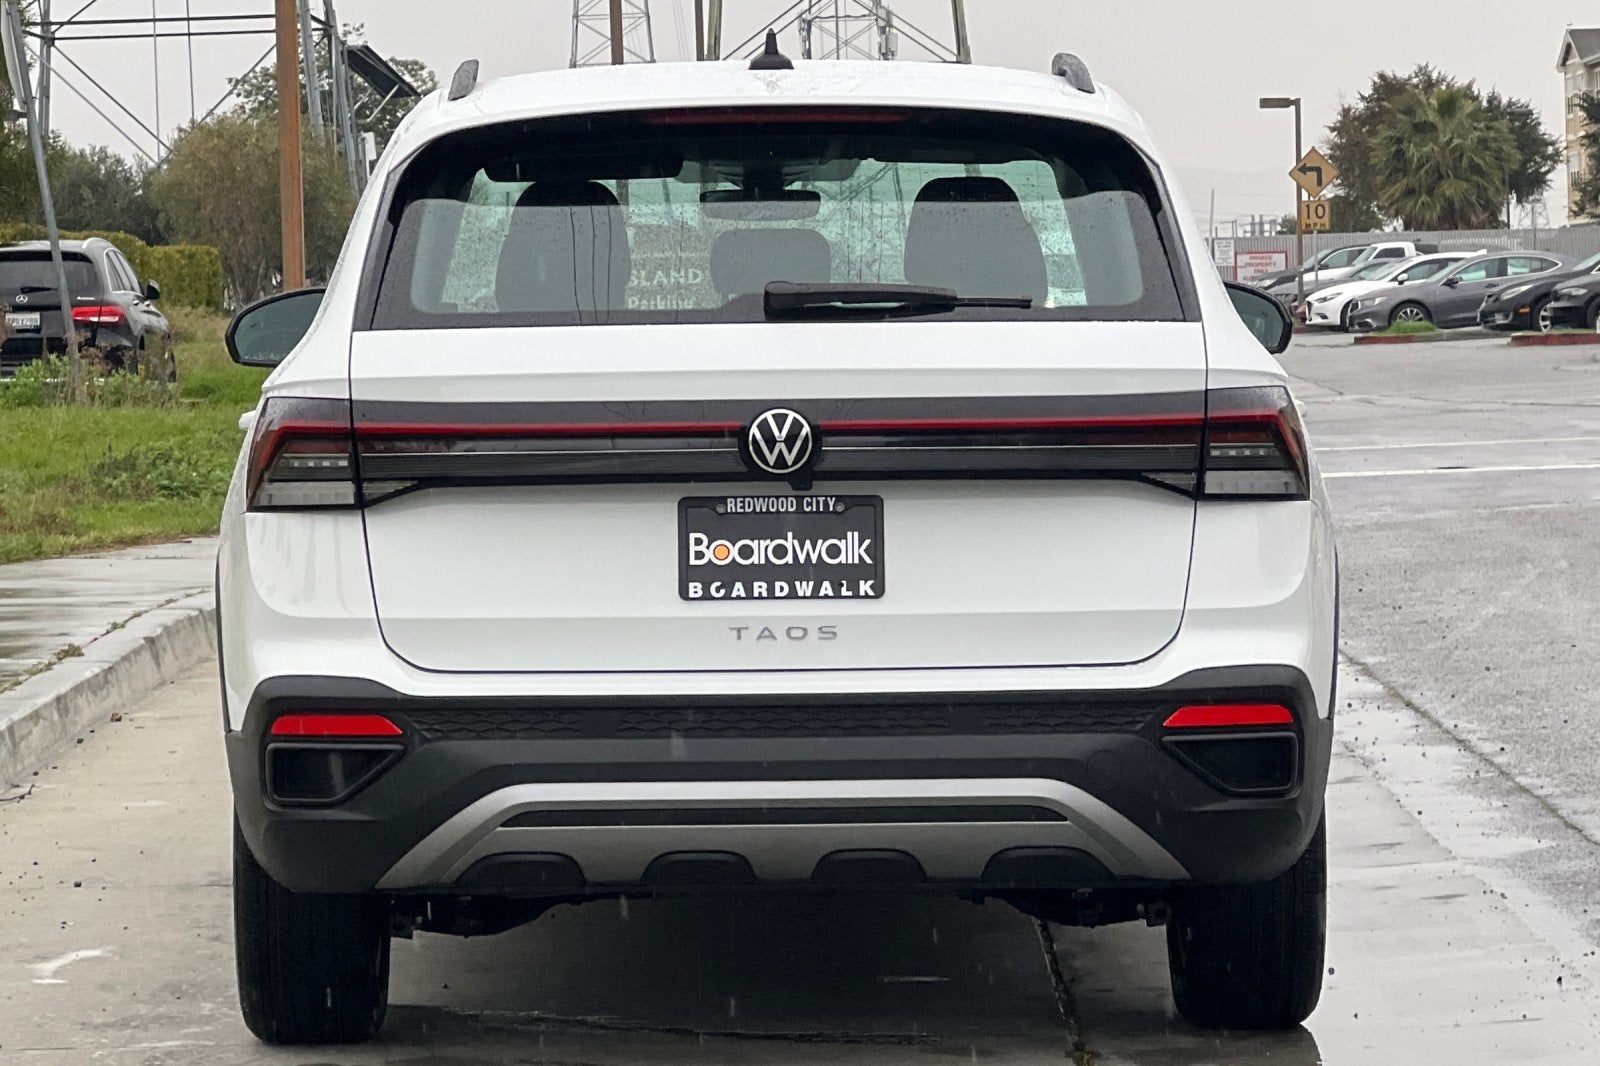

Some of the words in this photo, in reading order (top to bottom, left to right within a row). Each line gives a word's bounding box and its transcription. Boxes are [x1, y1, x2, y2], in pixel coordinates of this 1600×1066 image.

[1305, 203, 1326, 220] 10
[726, 497, 797, 513] REDWOOD
[803, 496, 836, 512] CITY
[688, 531, 874, 566] Boardwalk
[688, 580, 876, 598] BOARDWALK
[728, 625, 838, 641] TAOS
